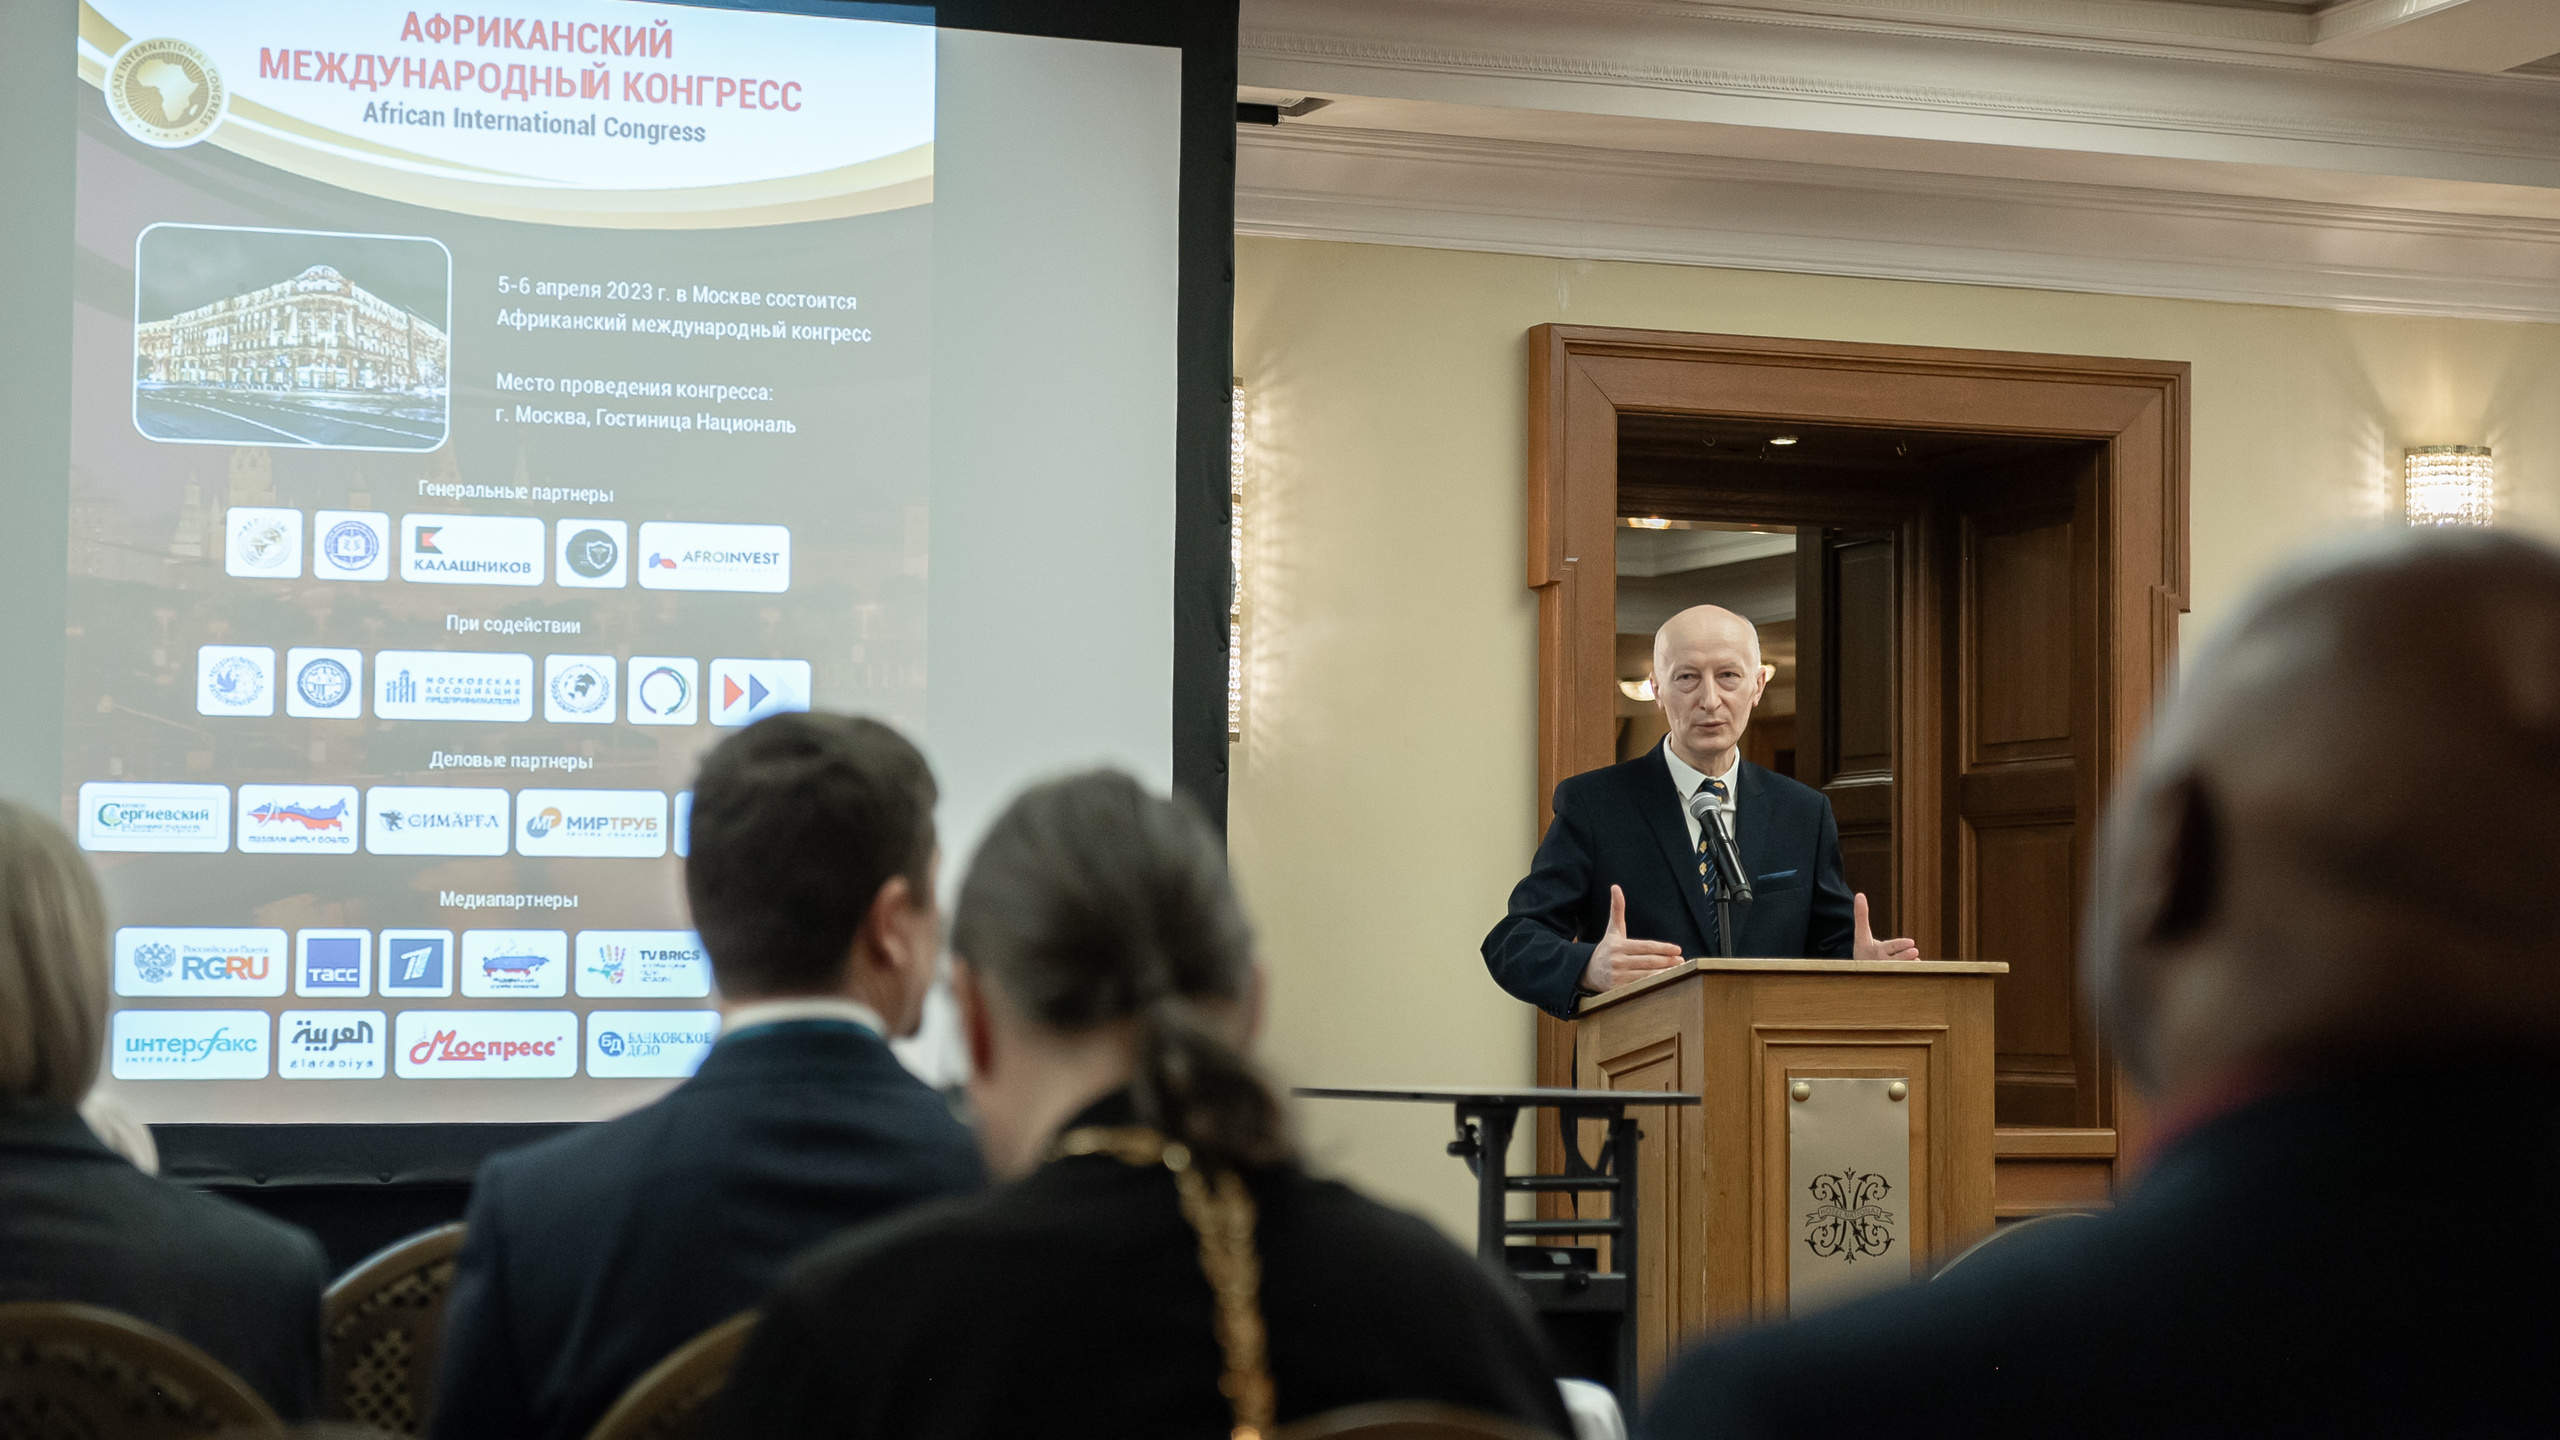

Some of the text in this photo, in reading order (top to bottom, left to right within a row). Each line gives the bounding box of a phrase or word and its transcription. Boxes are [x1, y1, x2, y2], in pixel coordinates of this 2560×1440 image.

[401, 11, 672, 59] АФРИКАНСКИЙ
[118, 40, 208, 72] INTERNATIONAL
[198, 67, 222, 128] CONGRESS
[259, 47, 802, 112] МЕЖДУНАРОДНЫЙ КОНГРЕСС
[363, 101, 706, 145] African International Congress
[498, 275, 857, 310] 5-6 апреля 2023 г. в Москве состоится
[496, 308, 872, 346] Африканский международный конгресс
[496, 372, 774, 404] Место проведения конгресса:
[495, 405, 797, 434] г. Москва, Гостиница Националь
[418, 479, 614, 505] Генеральные партнеры
[414, 559, 531, 574] КАЛАШНИКОВ
[682, 550, 780, 565] AFROINVEST
[446, 614, 581, 634] При содействии
[425, 677, 521, 686] МОСКОВСКАЯ
[425, 686, 521, 696] АССОЦИАЦИЯ
[429, 750, 593, 773] Деловые партнеры
[97, 803, 210, 828] Сергиевский
[566, 816, 659, 831] МИРТРУБ
[439, 891, 578, 909] Медиапартнеры
[639, 950, 700, 961] TV BRICS
[126, 1027, 258, 1063] интерфакс
[291, 1020, 374, 1052] العربية
[409, 1029, 556, 1065] Моспресс
[1820, 1207, 1880, 1219] HOTEL NATIONAL
